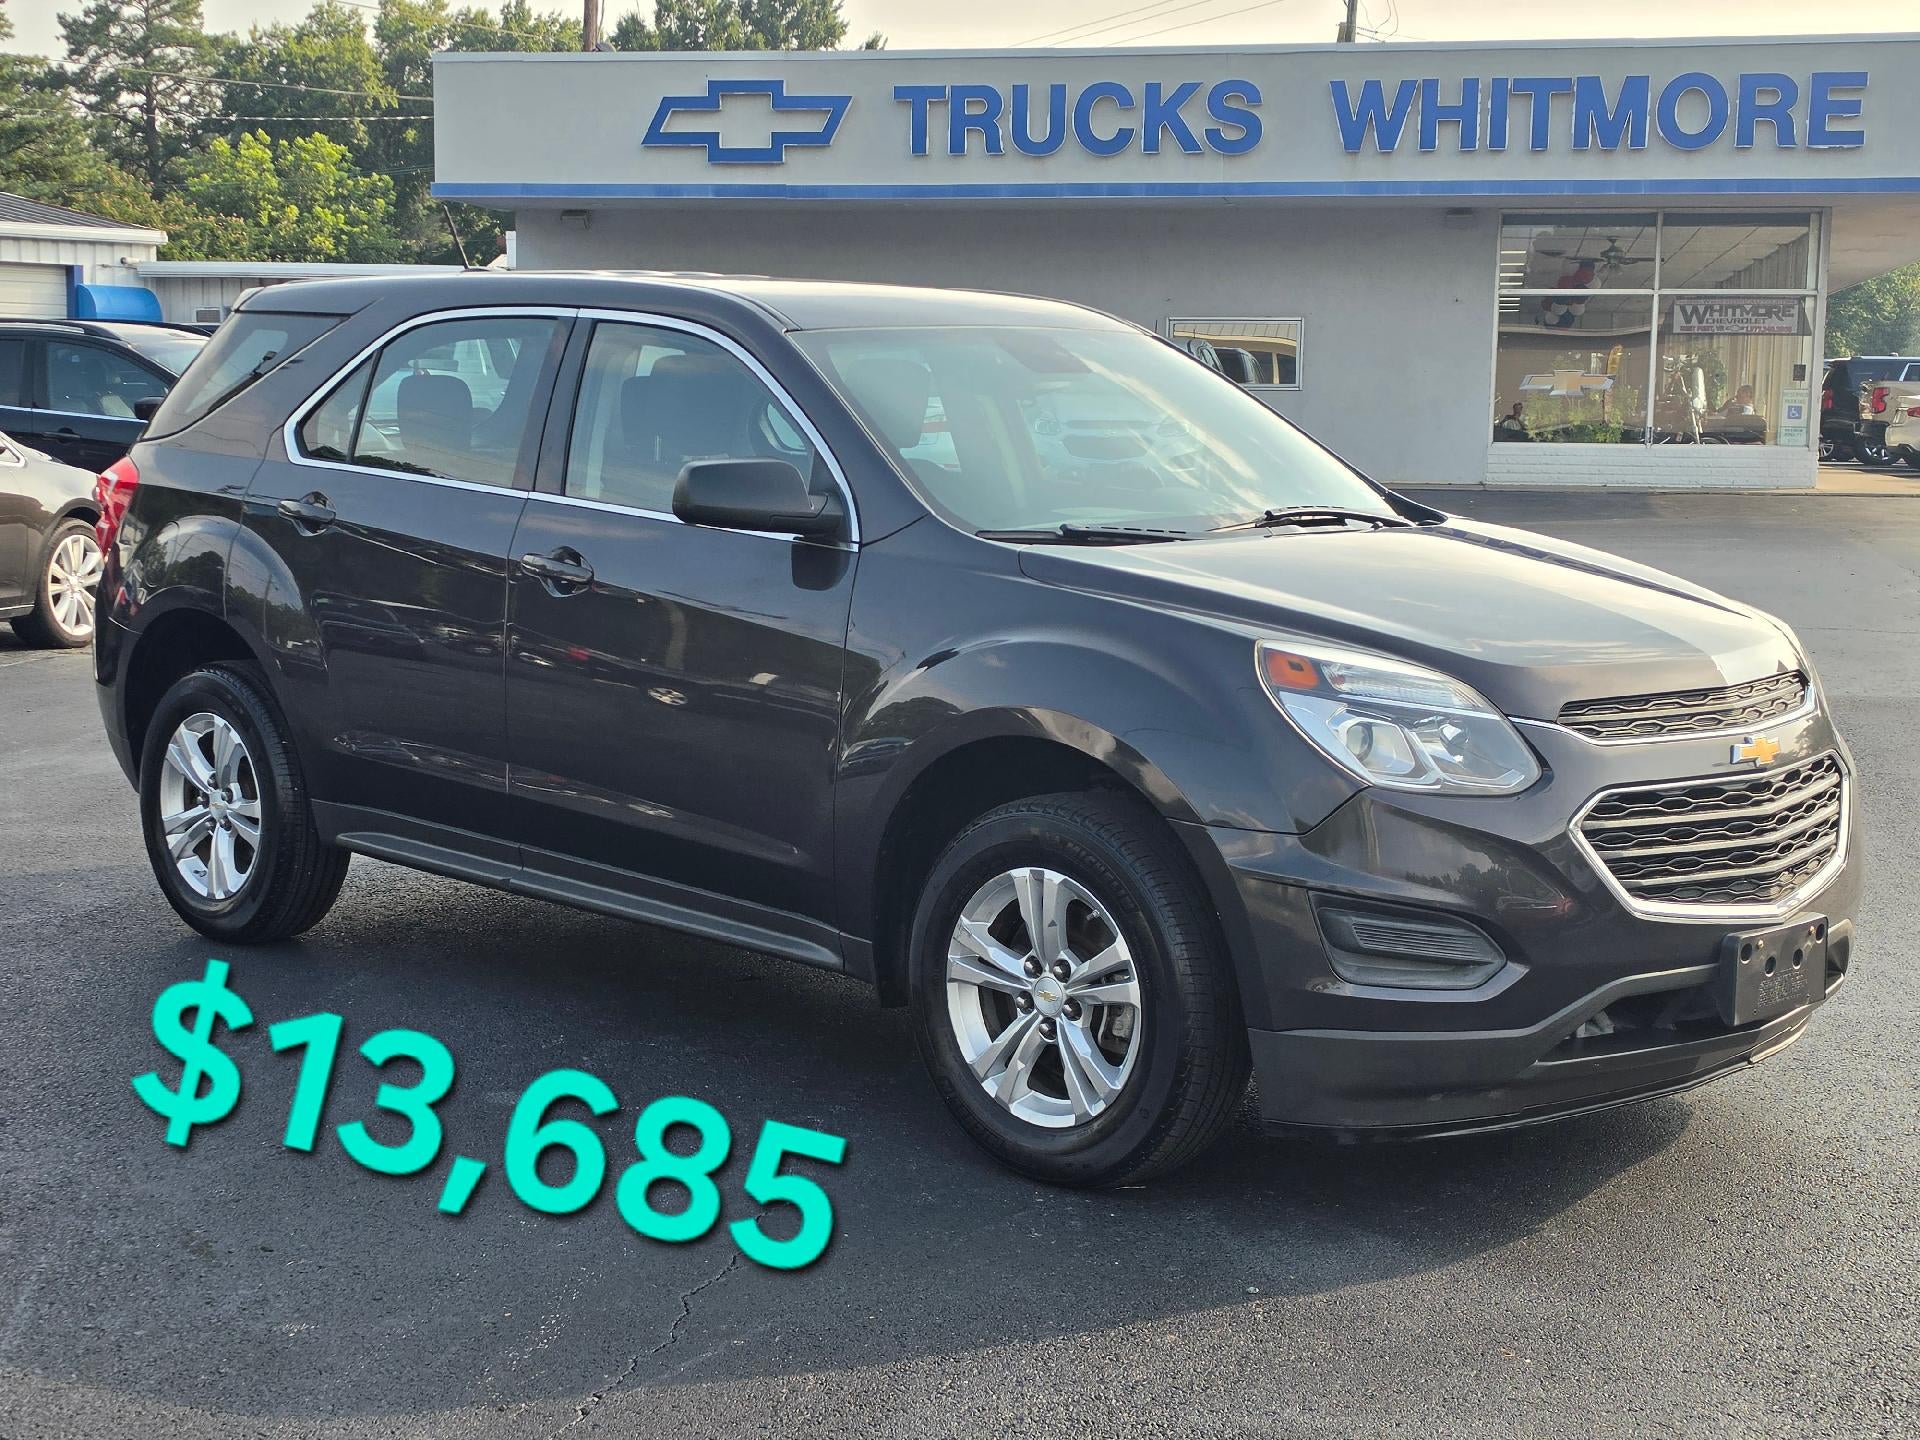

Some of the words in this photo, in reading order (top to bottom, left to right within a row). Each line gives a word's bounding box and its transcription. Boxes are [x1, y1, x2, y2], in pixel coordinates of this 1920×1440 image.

[892, 79, 1264, 157] TRUCKS
[1329, 71, 1869, 152] WHITMORE
[1680, 304, 1795, 325] WHITMORE
[1706, 317, 1767, 325] CHEVROLET
